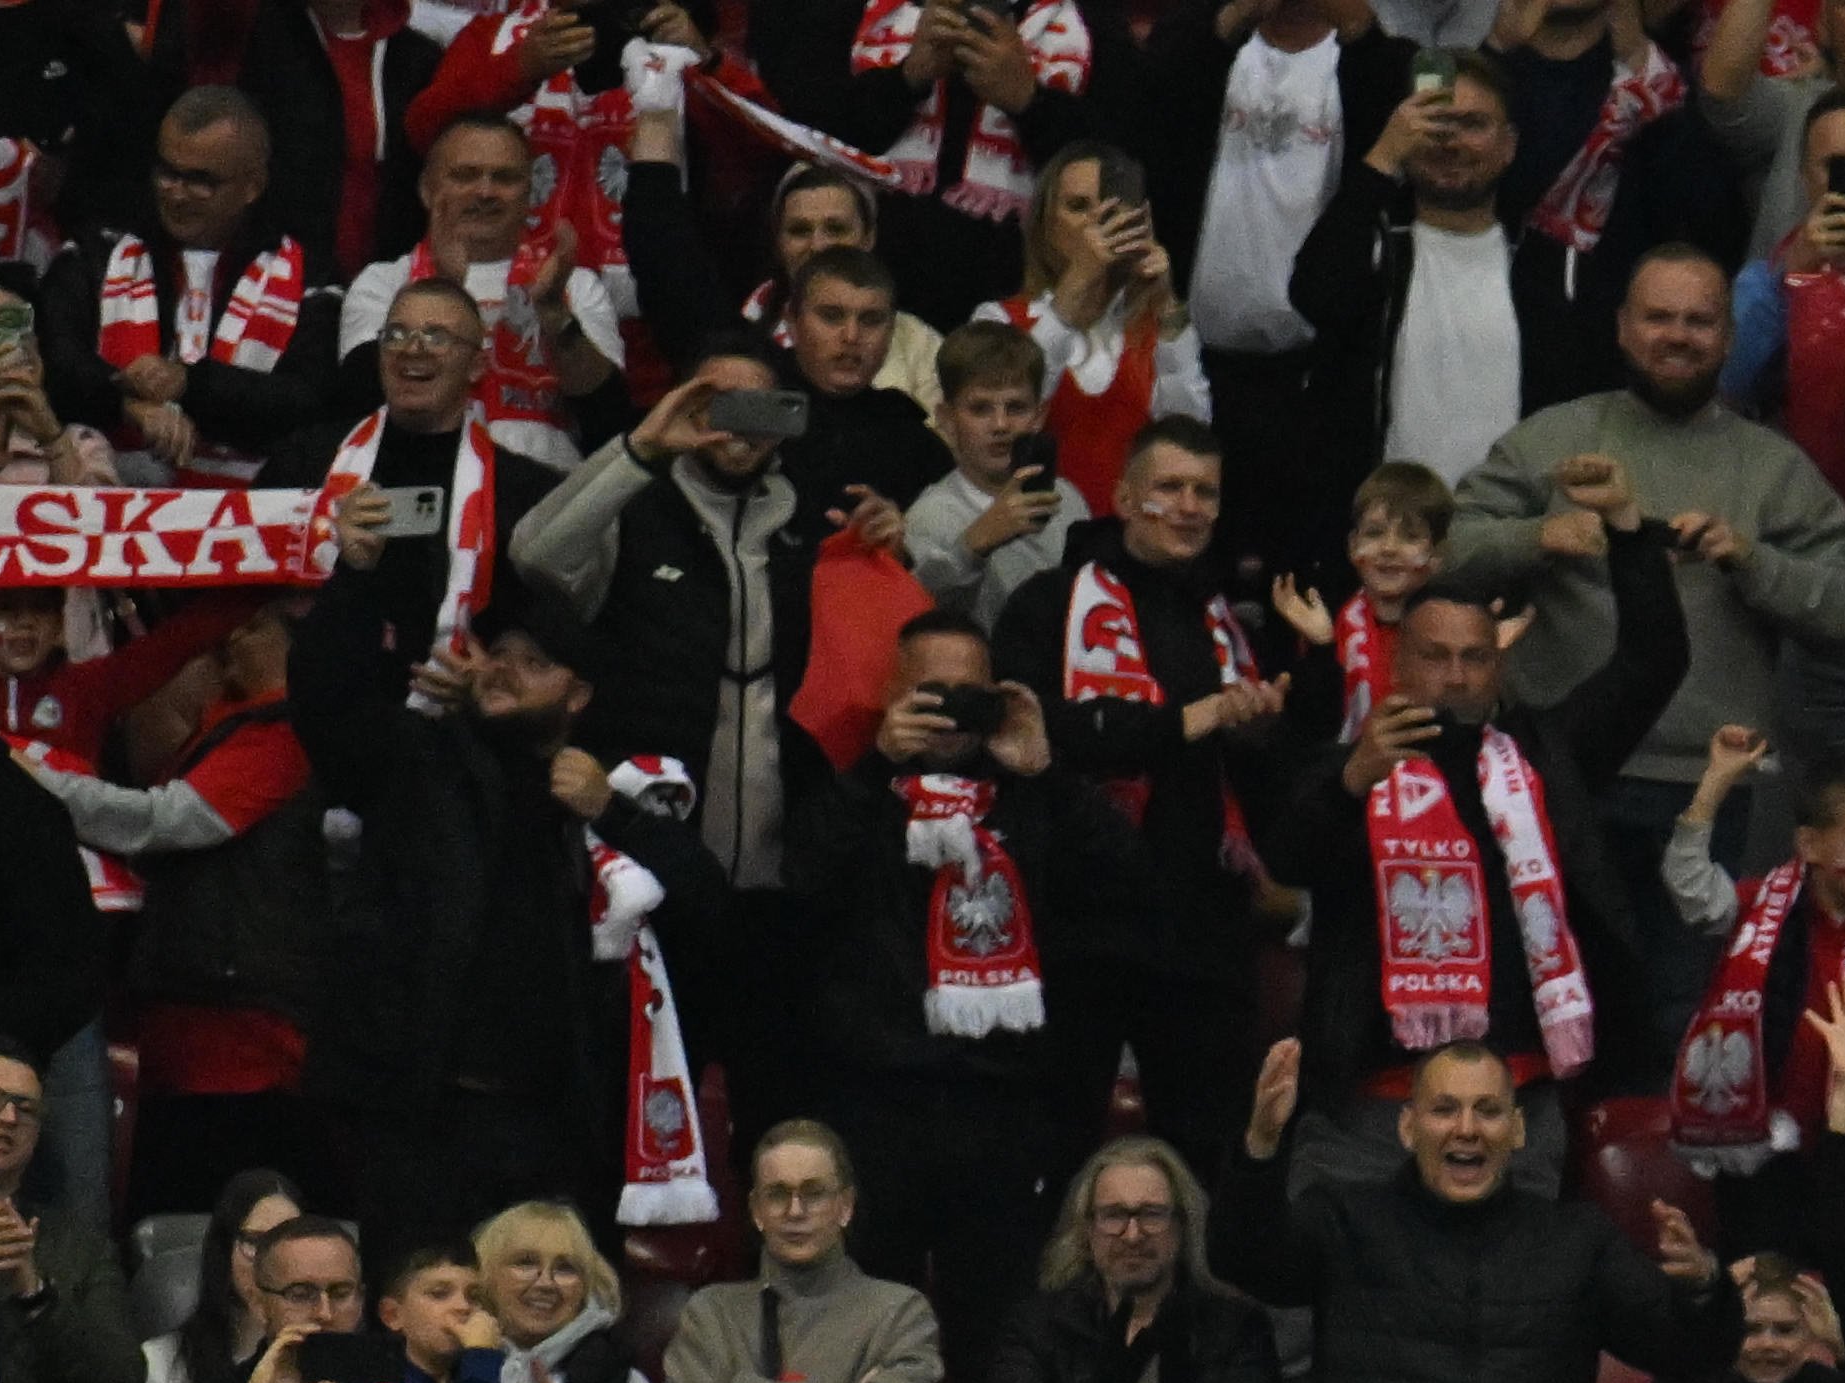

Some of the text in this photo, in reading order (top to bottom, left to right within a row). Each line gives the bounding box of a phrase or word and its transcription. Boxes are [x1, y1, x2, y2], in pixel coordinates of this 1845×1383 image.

[1381, 839, 1472, 859] TYLKO
[938, 964, 1036, 986] POLSKA
[1388, 973, 1484, 994] POLSKA
